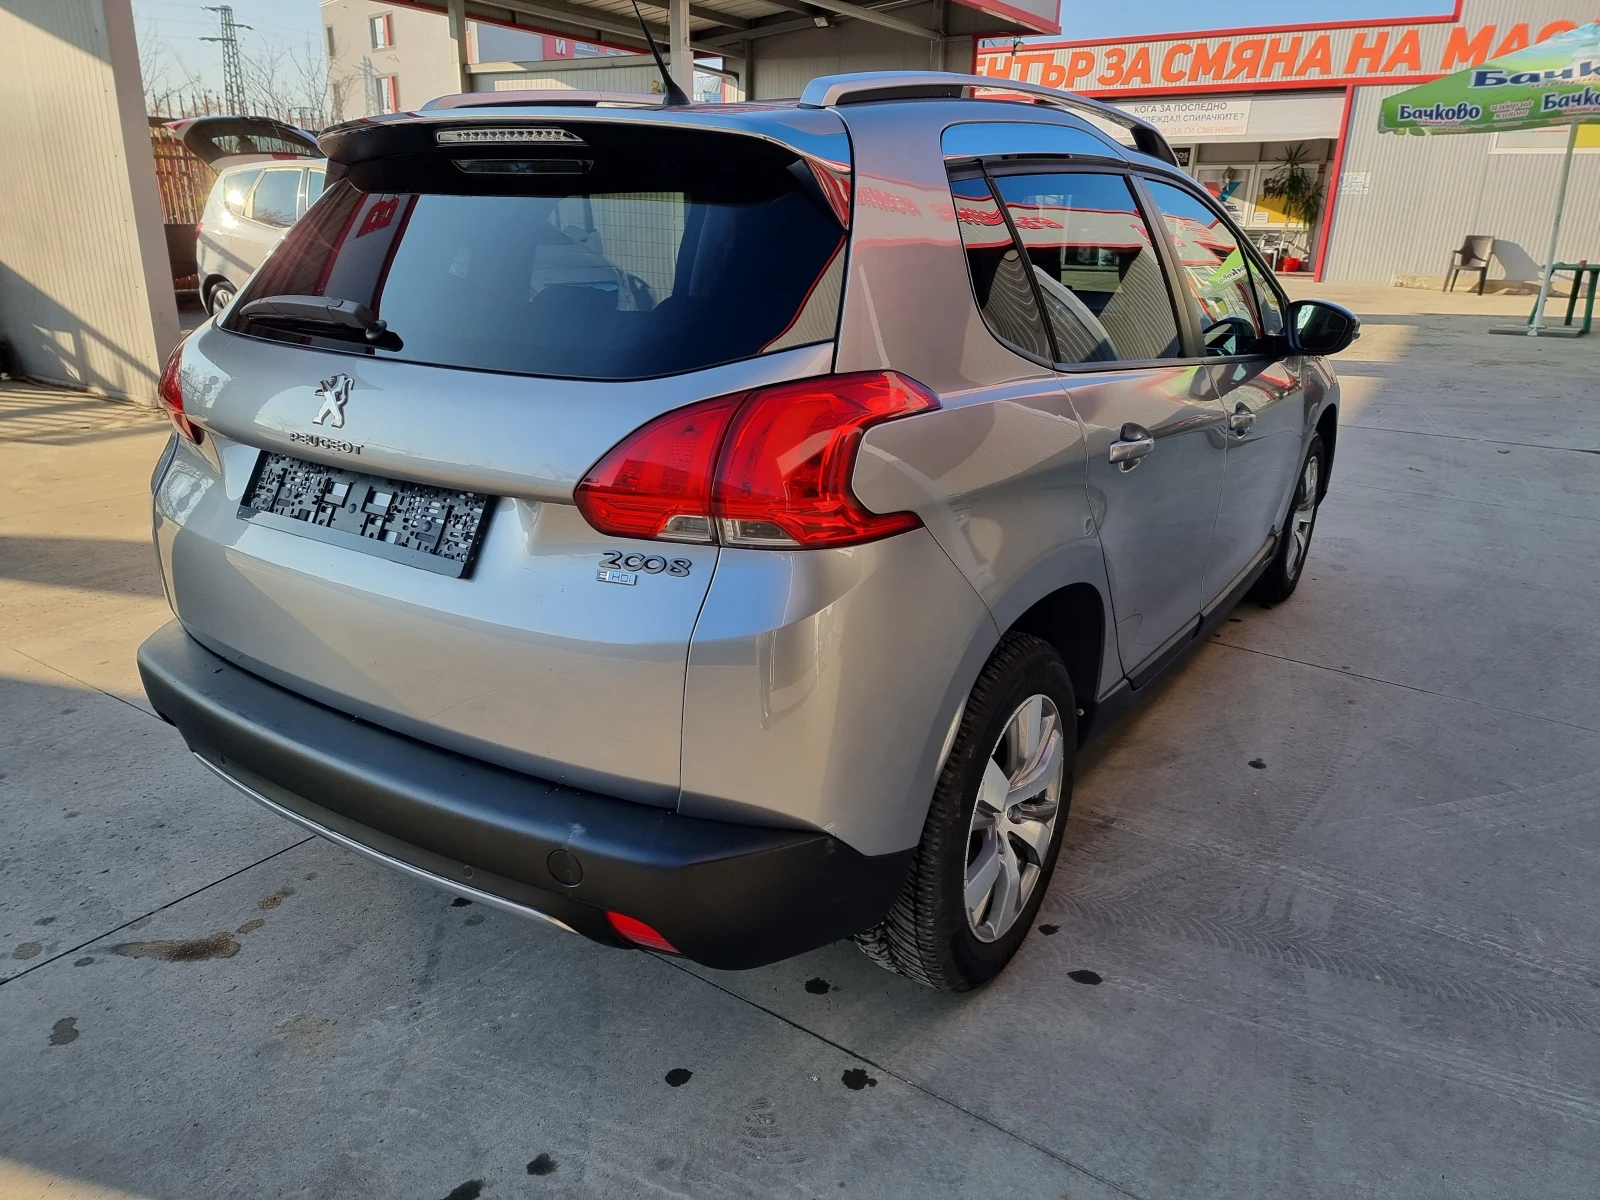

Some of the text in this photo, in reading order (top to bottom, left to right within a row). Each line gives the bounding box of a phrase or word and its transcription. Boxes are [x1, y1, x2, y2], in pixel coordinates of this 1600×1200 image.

[1097, 47, 1152, 86] ЗА
[1161, 35, 1332, 82] СМЯНА
[1343, 29, 1422, 75] НА
[1134, 102, 1228, 114] КОГА ЗА ПОСЛЕДНО
[1183, 112, 1245, 122] СПИРАЧКИТЕ?
[1399, 102, 1481, 120] Бачково
[290, 432, 364, 455] PEUGEOT
[599, 550, 692, 577] 2008
